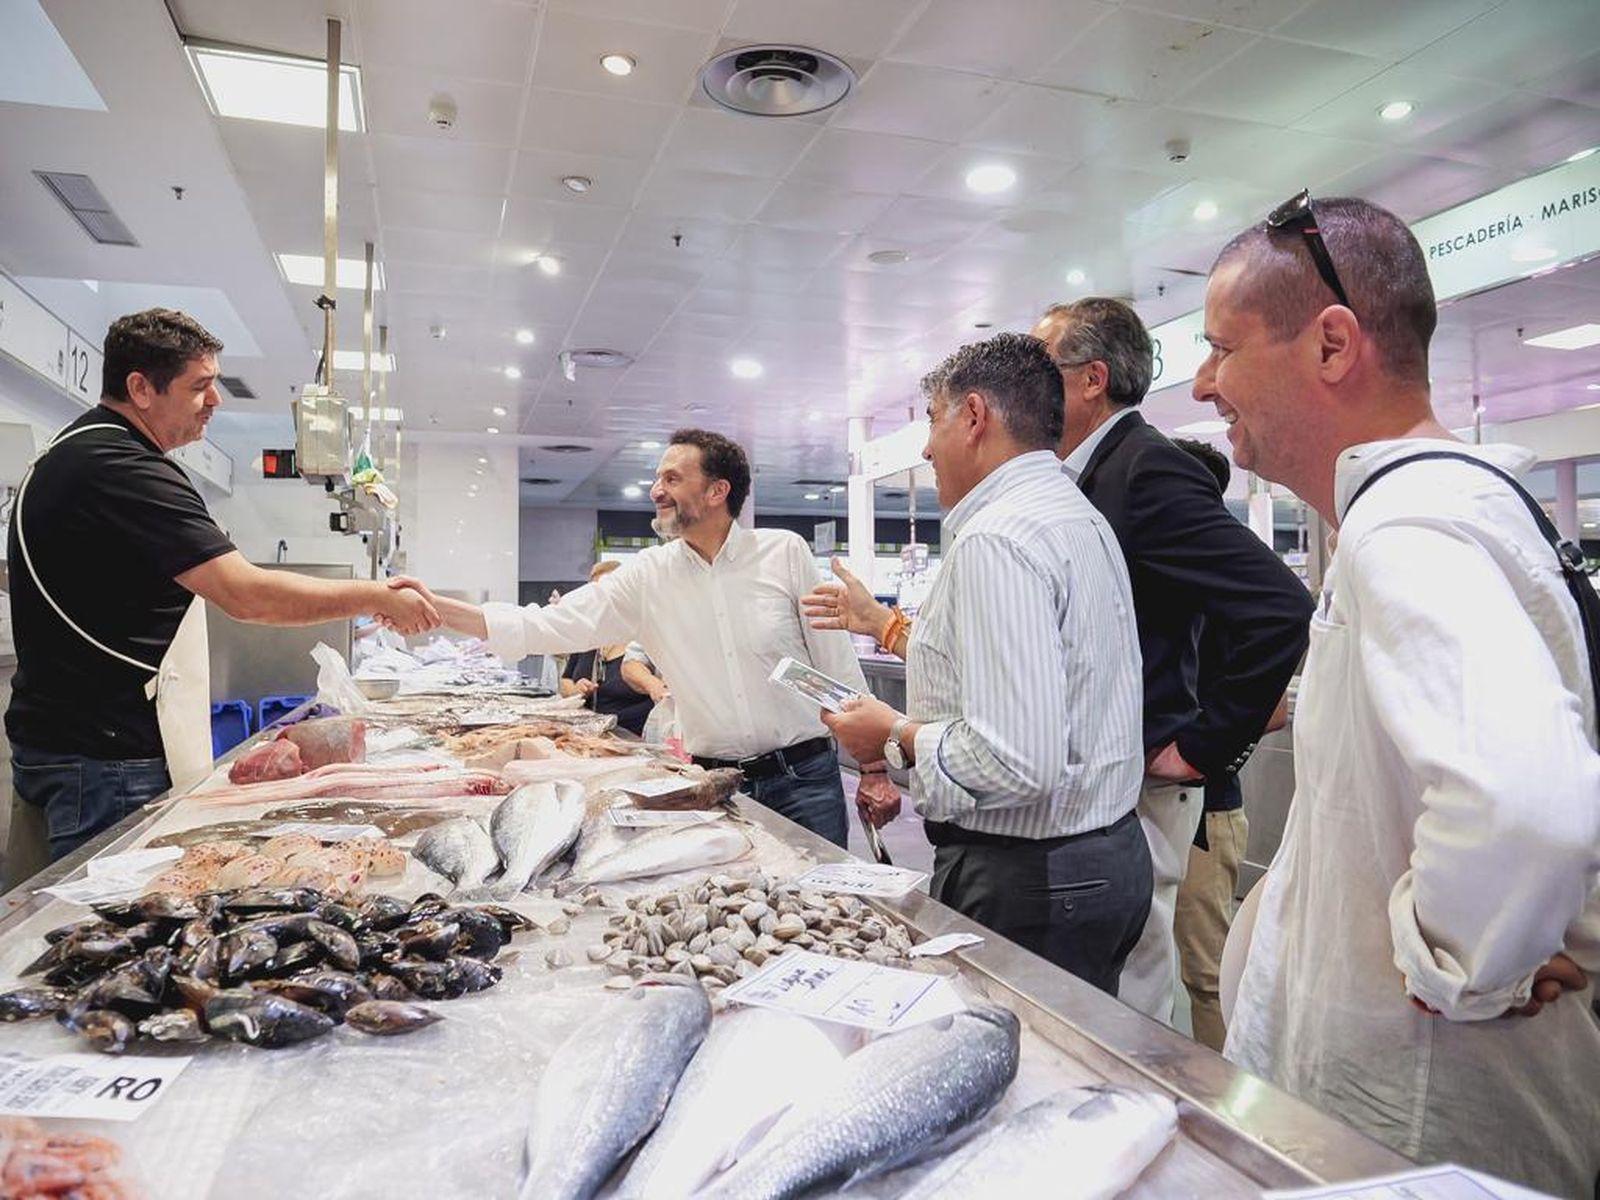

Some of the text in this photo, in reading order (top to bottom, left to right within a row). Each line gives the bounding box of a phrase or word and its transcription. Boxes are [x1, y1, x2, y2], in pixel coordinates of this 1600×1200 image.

[1429, 187, 1600, 259] PESCADERÍA MARIS
[71, 345, 88, 393] 12
